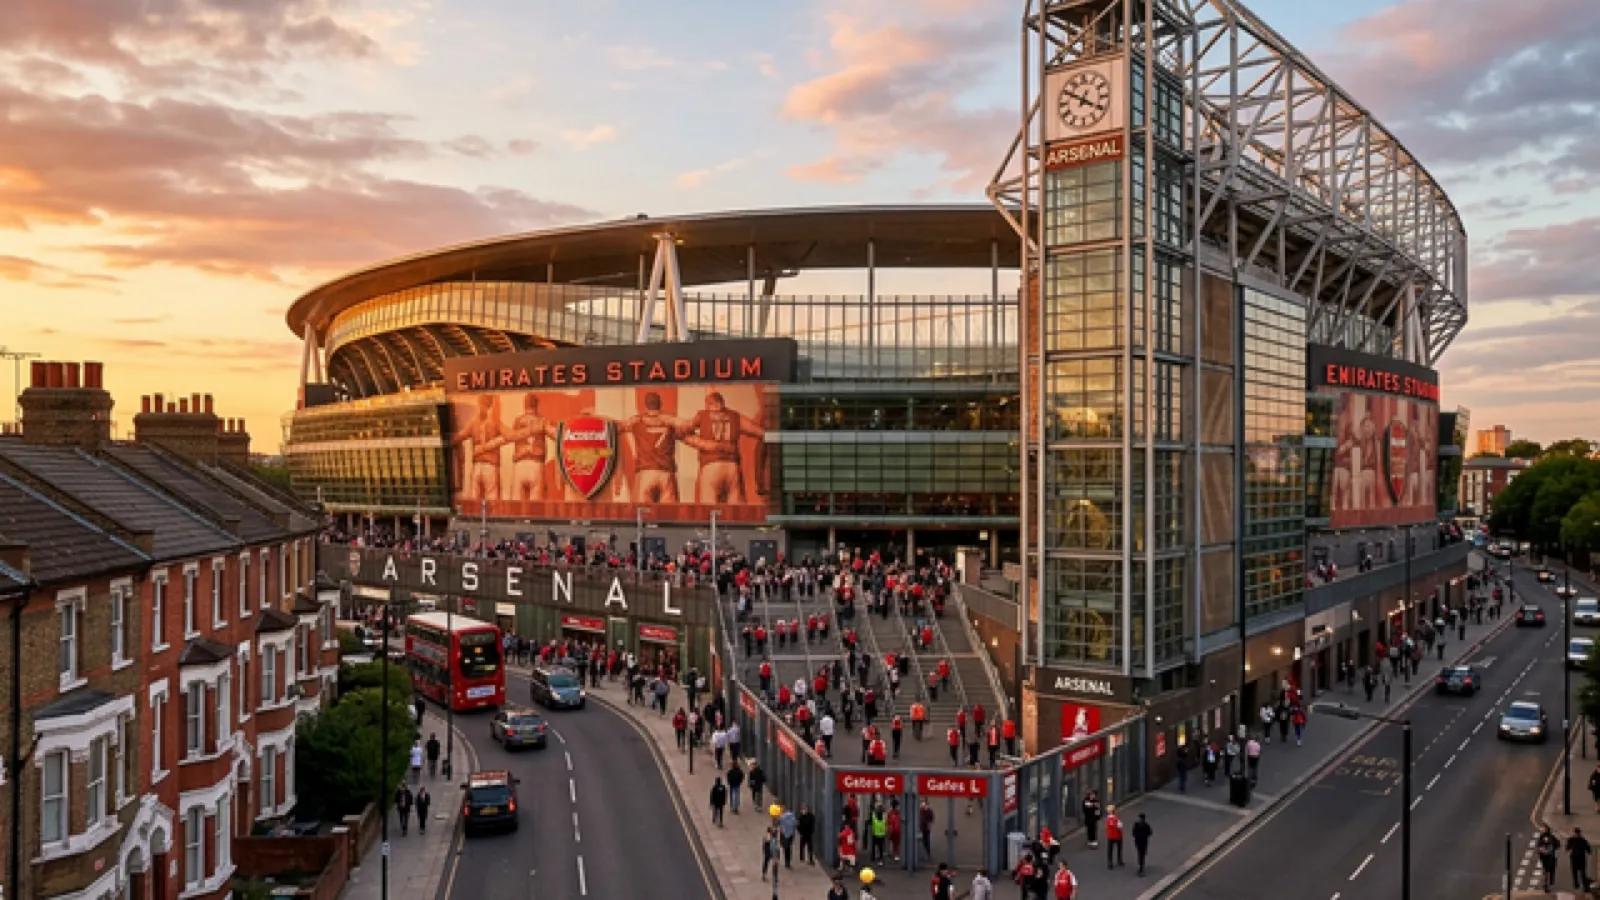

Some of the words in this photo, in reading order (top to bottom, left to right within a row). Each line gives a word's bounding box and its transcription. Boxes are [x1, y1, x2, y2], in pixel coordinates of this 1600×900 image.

[1046, 140, 1121, 165] ARSENAL
[456, 364, 587, 391] EMIRATES
[606, 356, 761, 381] STADIUM
[1326, 363, 1401, 391] EMIRATES
[382, 554, 681, 616] ARSENAL
[1054, 676, 1115, 696] ARSENAL
[884, 776, 896, 791] C
[969, 779, 981, 794] L
